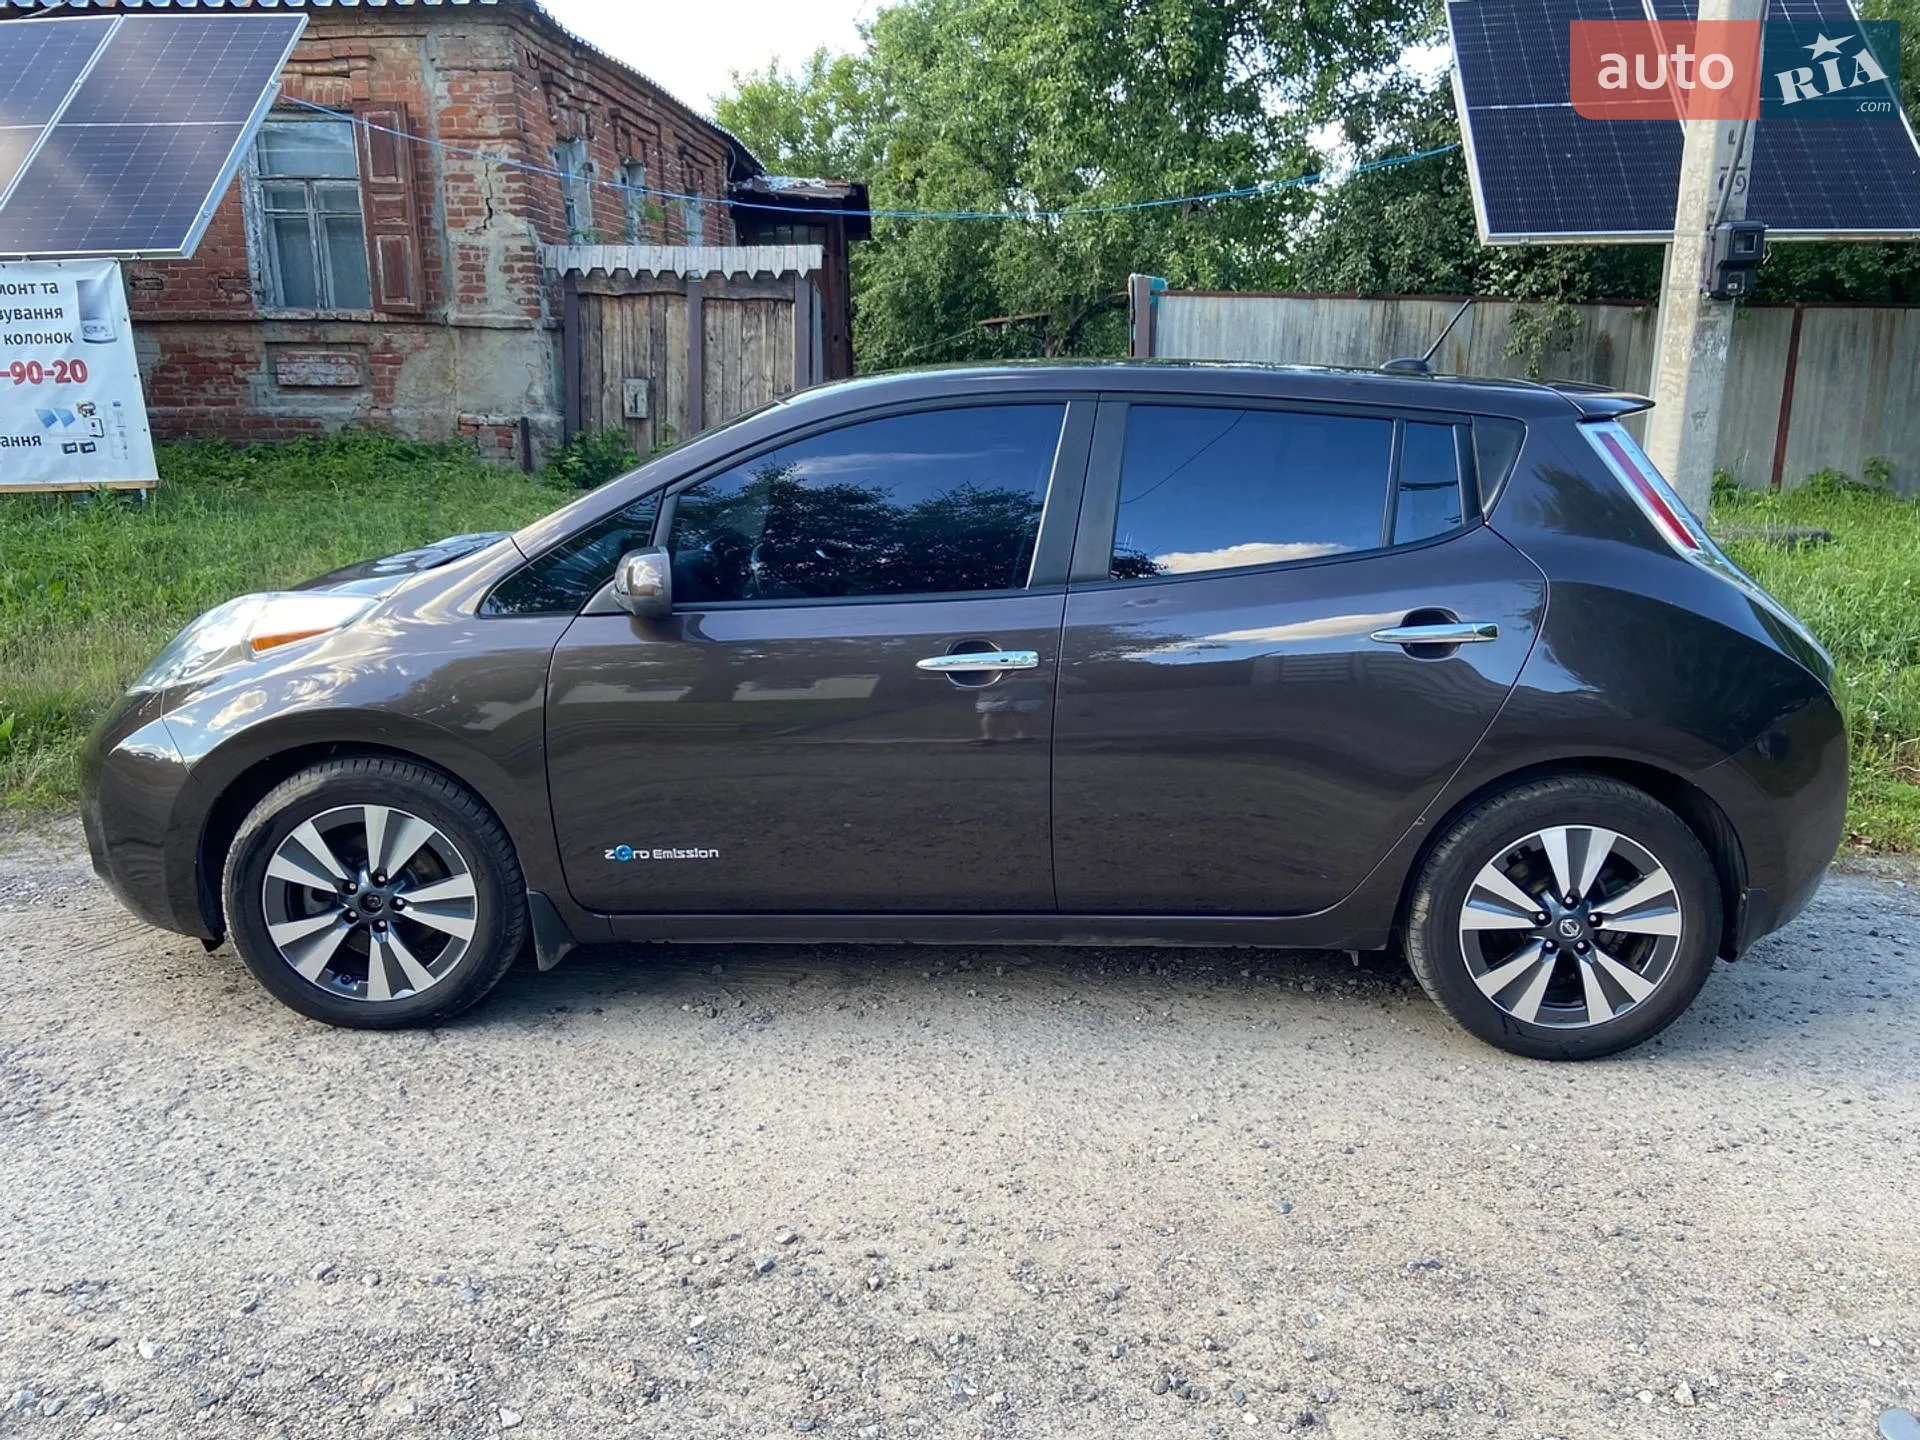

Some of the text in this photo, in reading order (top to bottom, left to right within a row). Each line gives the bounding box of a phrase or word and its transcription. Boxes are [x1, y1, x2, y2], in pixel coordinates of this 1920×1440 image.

[41, 281, 59, 294] та
[4, 331, 73, 345] колонок
[0, 434, 42, 447] ання
